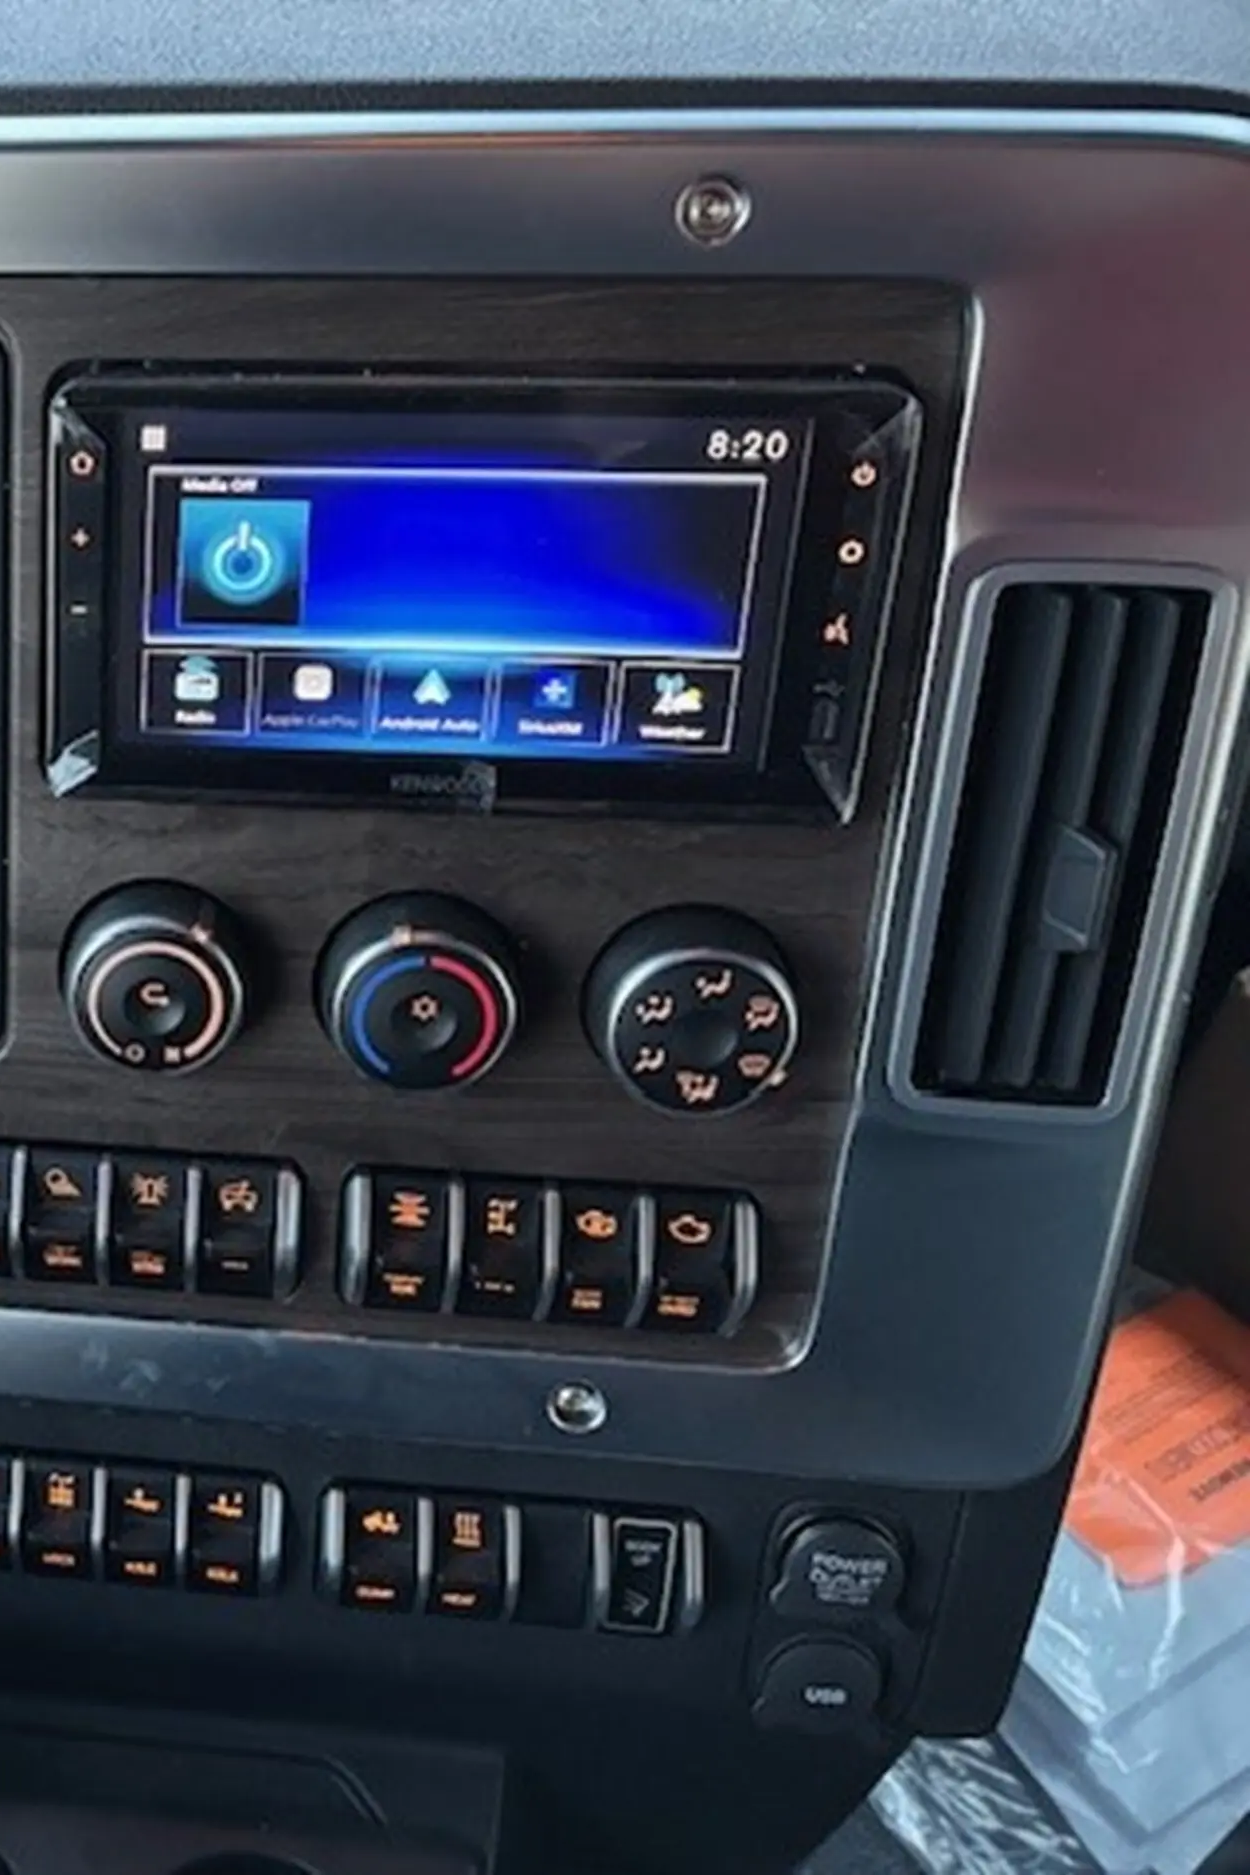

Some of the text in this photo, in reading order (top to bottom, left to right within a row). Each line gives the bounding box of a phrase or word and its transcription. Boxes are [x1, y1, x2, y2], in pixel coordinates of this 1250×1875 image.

[707, 428, 790, 461] 8:20
[380, 716, 480, 734] Android Auto
[812, 1552, 888, 1575] POWER
[804, 1687, 847, 1705] USB
